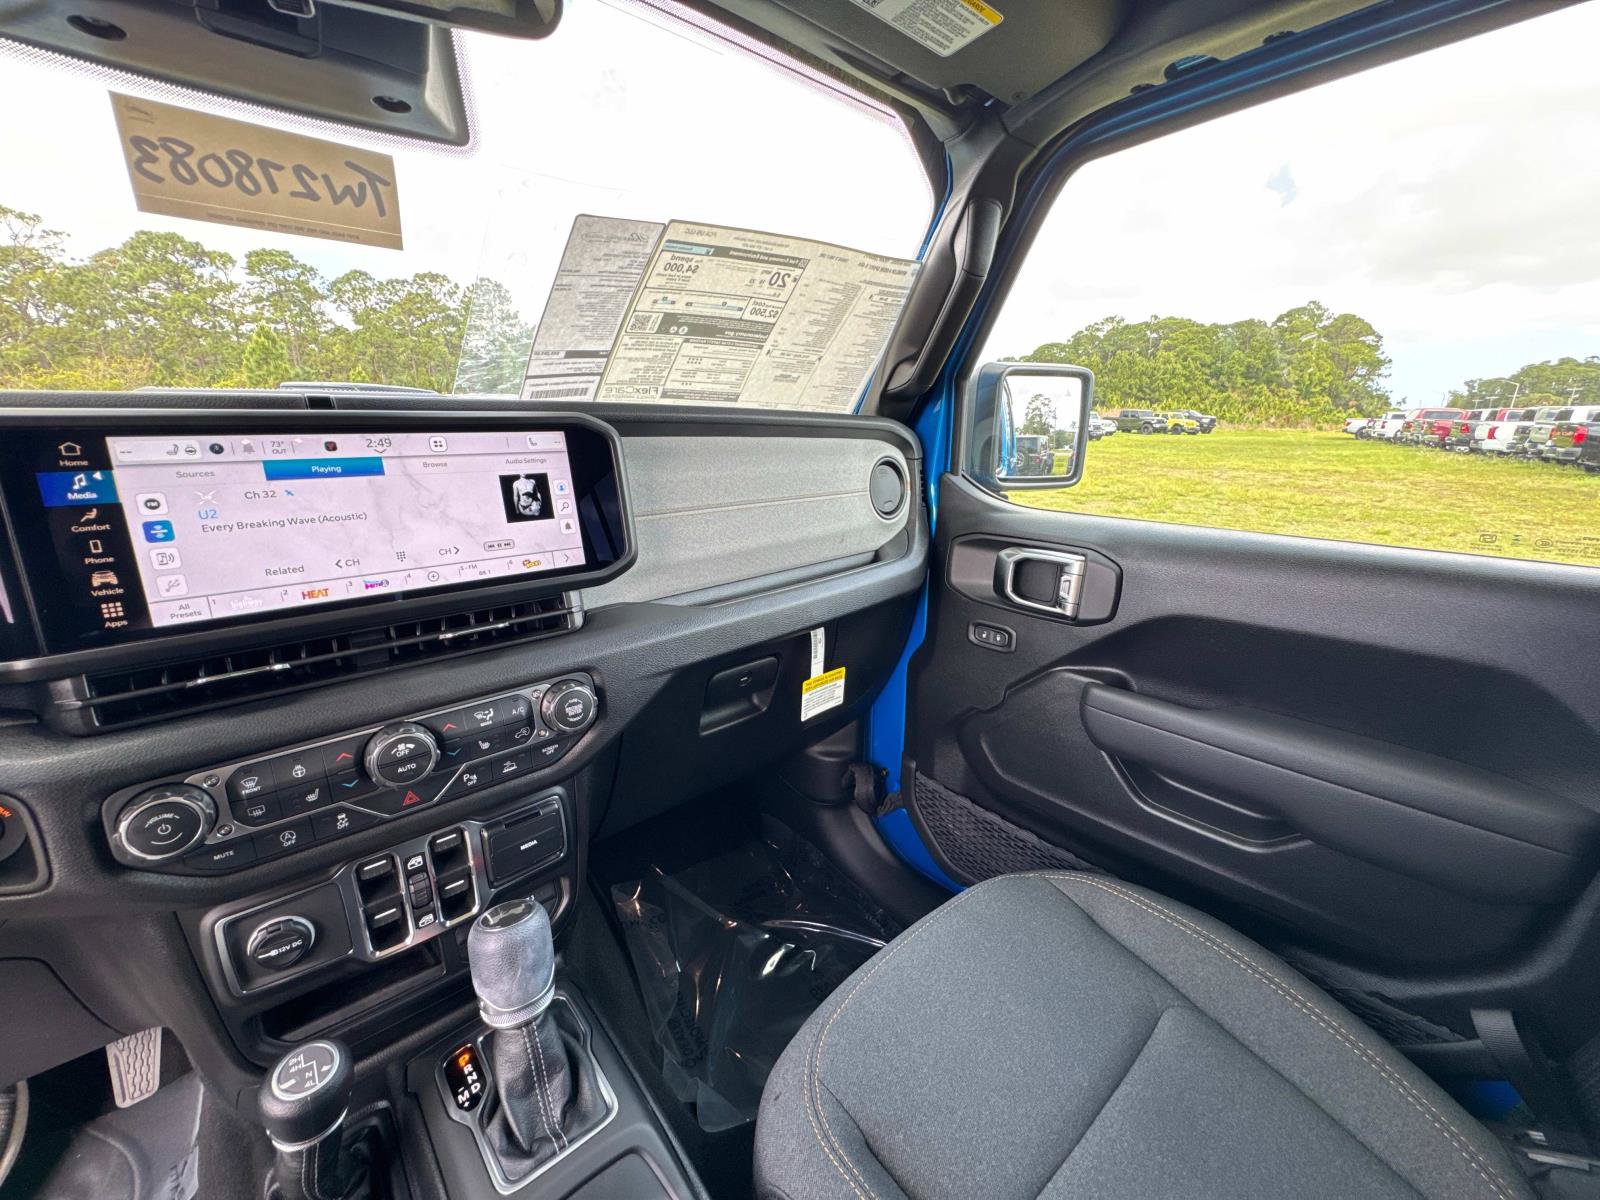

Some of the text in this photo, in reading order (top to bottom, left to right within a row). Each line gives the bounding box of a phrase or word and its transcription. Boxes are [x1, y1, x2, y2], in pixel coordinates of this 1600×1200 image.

[366, 438, 392, 448] 2:49
[176, 470, 215, 479] Sources
[312, 465, 342, 474] Playing
[67, 492, 98, 500] Media
[244, 490, 277, 500] Ch 32
[198, 509, 218, 520] U2
[71, 523, 111, 532] Comfort
[202, 512, 368, 534] Every Breaking Wave (Acoustic)
[85, 555, 114, 565] Phone
[345, 558, 360, 567] CH
[265, 565, 305, 577] Related
[91, 586, 124, 597] Vehicle
[302, 588, 329, 600] HEAT
[170, 610, 202, 620] Presets
[105, 618, 128, 628] Apps
[512, 706, 525, 715] A/C
[396, 749, 410, 758] OFF
[397, 763, 416, 773] AUTO
[467, 778, 478, 787] OFF
[242, 786, 261, 795] FRONT
[338, 821, 349, 830] OFF
[520, 840, 538, 850] MEDIA
[213, 850, 235, 860] MUTE
[279, 940, 303, 953] 12V DC
[289, 1056, 301, 1066] 2H
[458, 1054, 470, 1067] P
[290, 1064, 302, 1073] 4H
[464, 1064, 473, 1074] R
[306, 1070, 312, 1079] N
[471, 1082, 481, 1094] D
[458, 1090, 470, 1104] M
